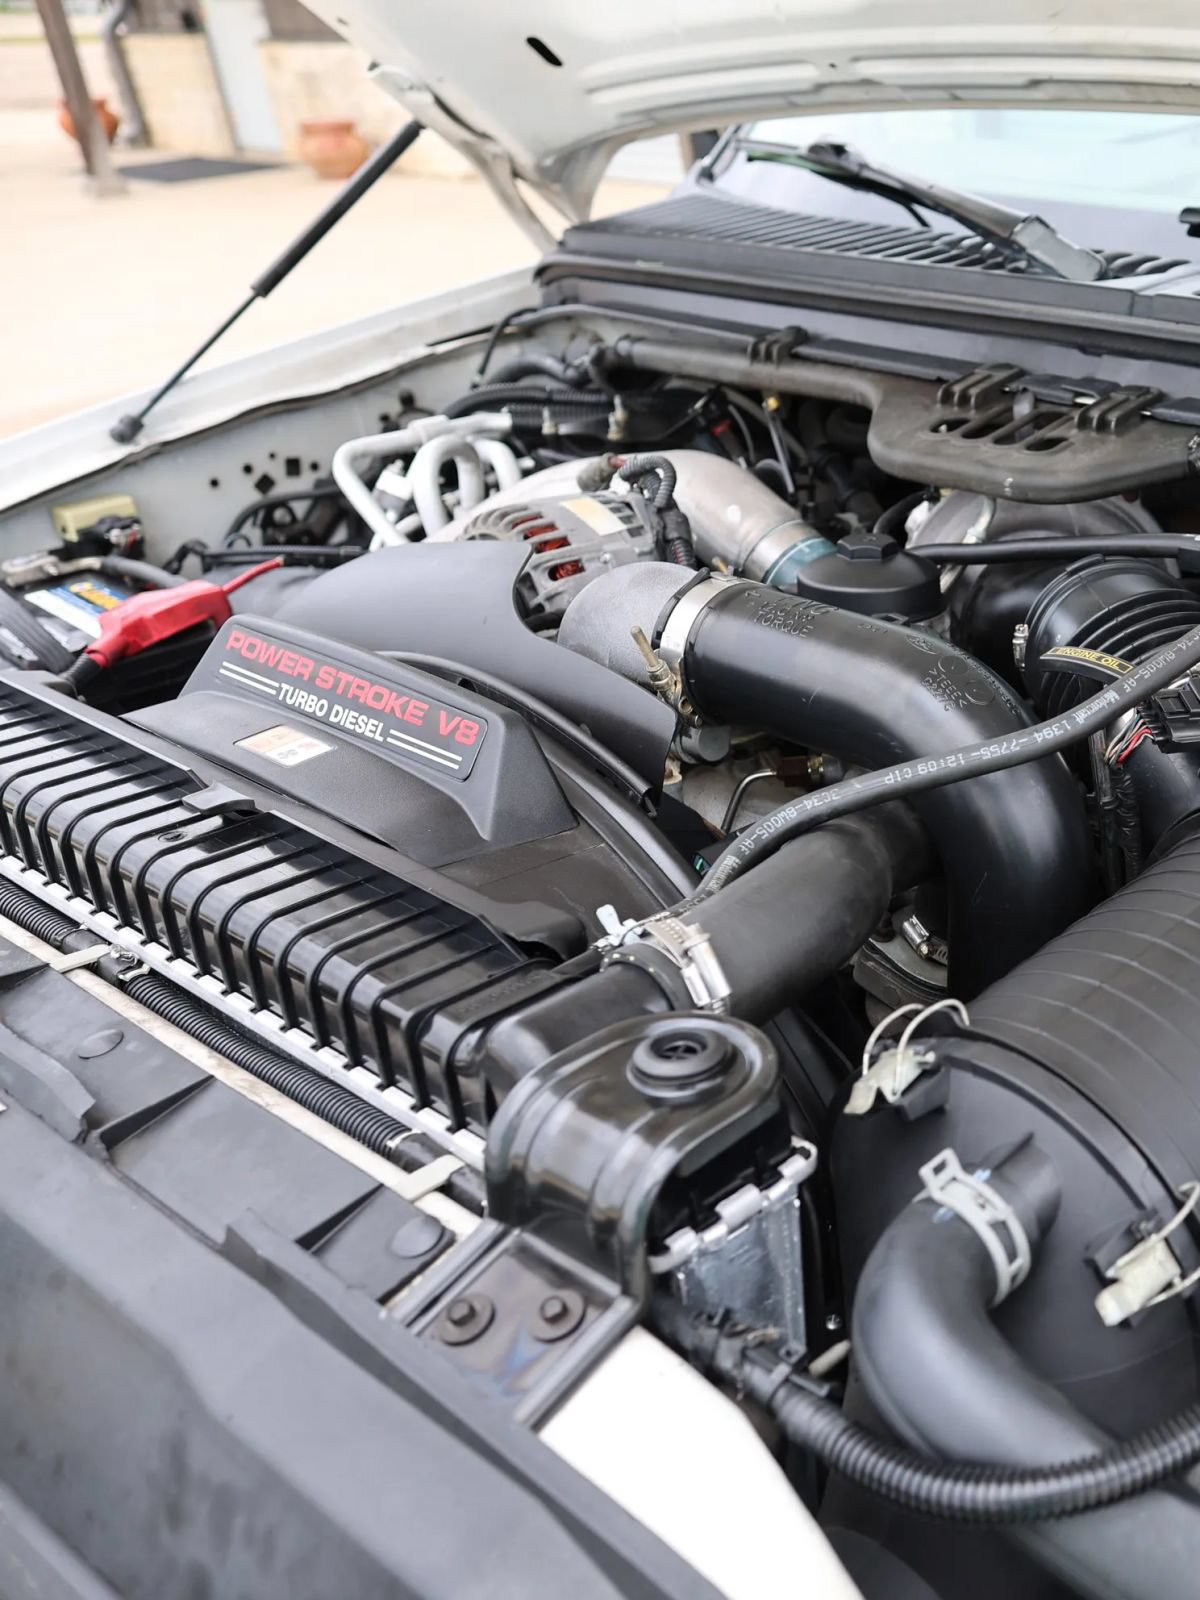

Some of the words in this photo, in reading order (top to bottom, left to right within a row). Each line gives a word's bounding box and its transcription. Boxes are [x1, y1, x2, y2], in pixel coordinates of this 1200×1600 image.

[753, 611, 815, 638] TORQUE
[1056, 648, 1099, 661] ENGINE
[1101, 656, 1120, 670] OIL
[225, 630, 316, 681] POWER
[315, 666, 430, 727] STROKE
[439, 710, 480, 746] V8
[278, 683, 328, 717] TURBO
[329, 705, 385, 742] DIESEL
[1034, 719, 1071, 743] 1394
[918, 753, 965, 775] 12:09
[738, 788, 841, 854] 3C34-8W005-AF
